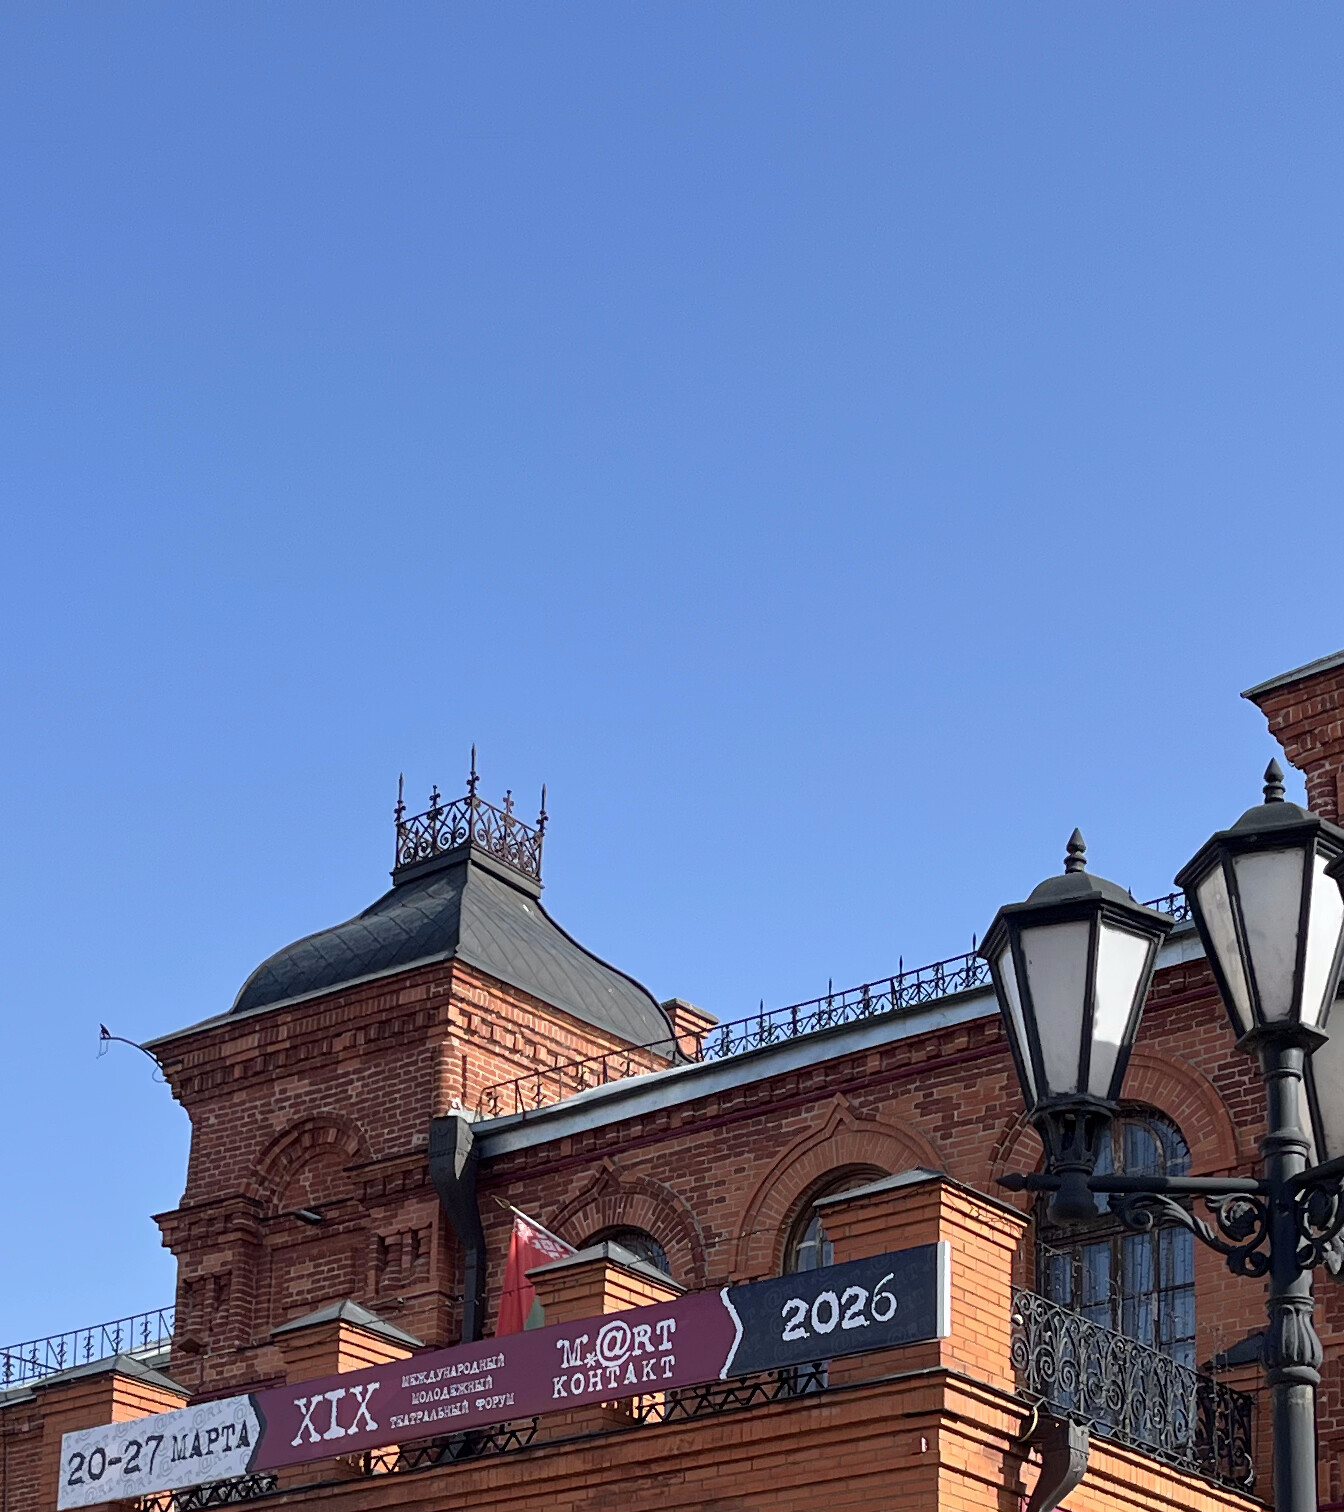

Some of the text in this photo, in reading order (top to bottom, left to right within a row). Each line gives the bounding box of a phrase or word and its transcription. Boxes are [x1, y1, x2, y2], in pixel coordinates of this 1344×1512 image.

[781, 1272, 898, 1342] 2026
[401, 1352, 505, 1388] МЕЖДУНАРОДНЫЙ
[411, 1374, 493, 1405] МОЛОДЕЖНЫЙ
[552, 1355, 676, 1399] КОНТАКТ
[290, 1382, 381, 1447] XIX
[389, 1392, 515, 1429] ТЕАТРАЛЬНЫЙ ФОРУМ
[67, 1419, 251, 1487] 20-27 МАРТА
